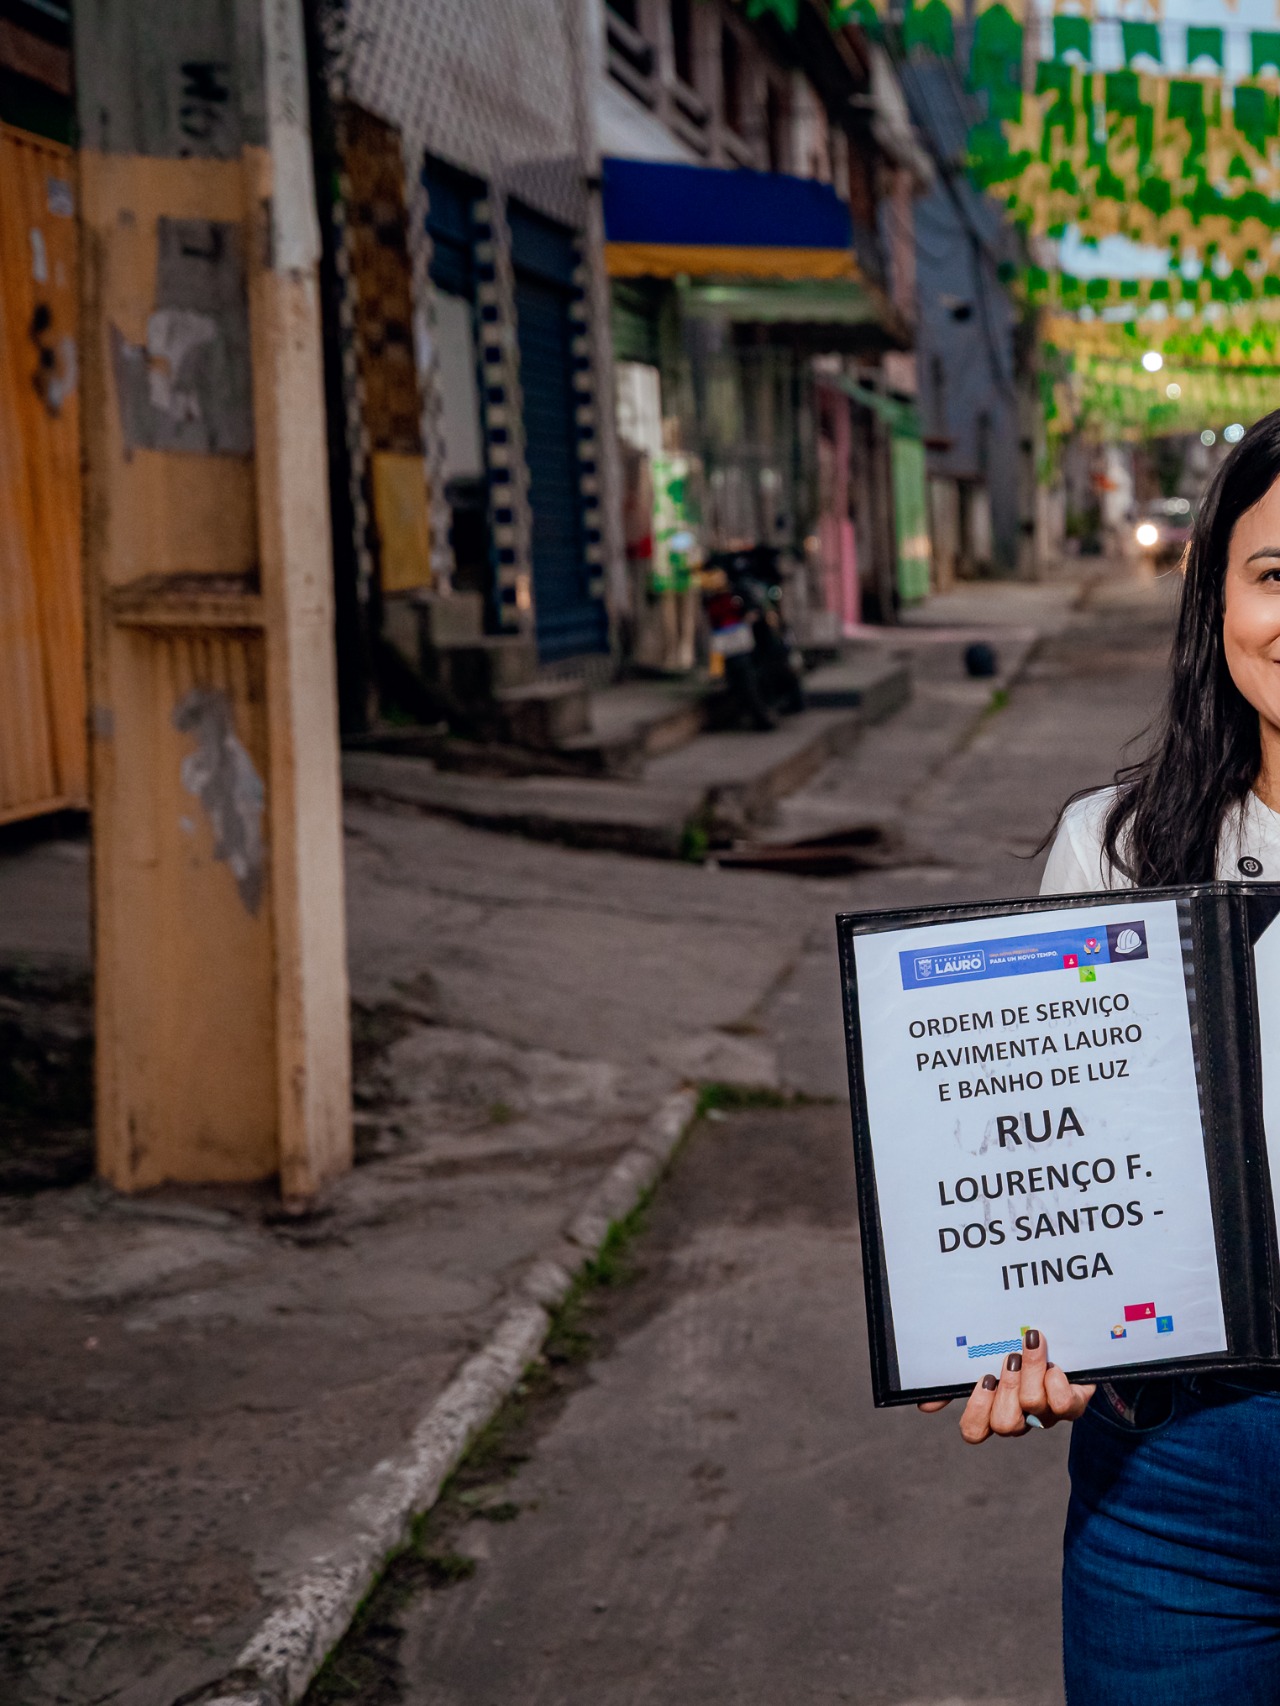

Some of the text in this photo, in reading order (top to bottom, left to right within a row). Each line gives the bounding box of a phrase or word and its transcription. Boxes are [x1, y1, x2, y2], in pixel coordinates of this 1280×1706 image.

[934, 954, 980, 962] PREFEITURA
[935, 958, 982, 974] LAURO
[909, 994, 1129, 1038] ORDEM DE SERVIÇO
[916, 1024, 1142, 1071] PAVIMENTA LAURO
[939, 1059, 1129, 1102] E BANHO DE LUZ
[997, 1107, 1085, 1147] RUA
[939, 1154, 1152, 1206] LOURENÇO F.
[939, 1220, 1005, 1253] DOS
[1015, 1201, 1143, 1241] SANTOS
[1002, 1252, 1113, 1290] ITINGA
